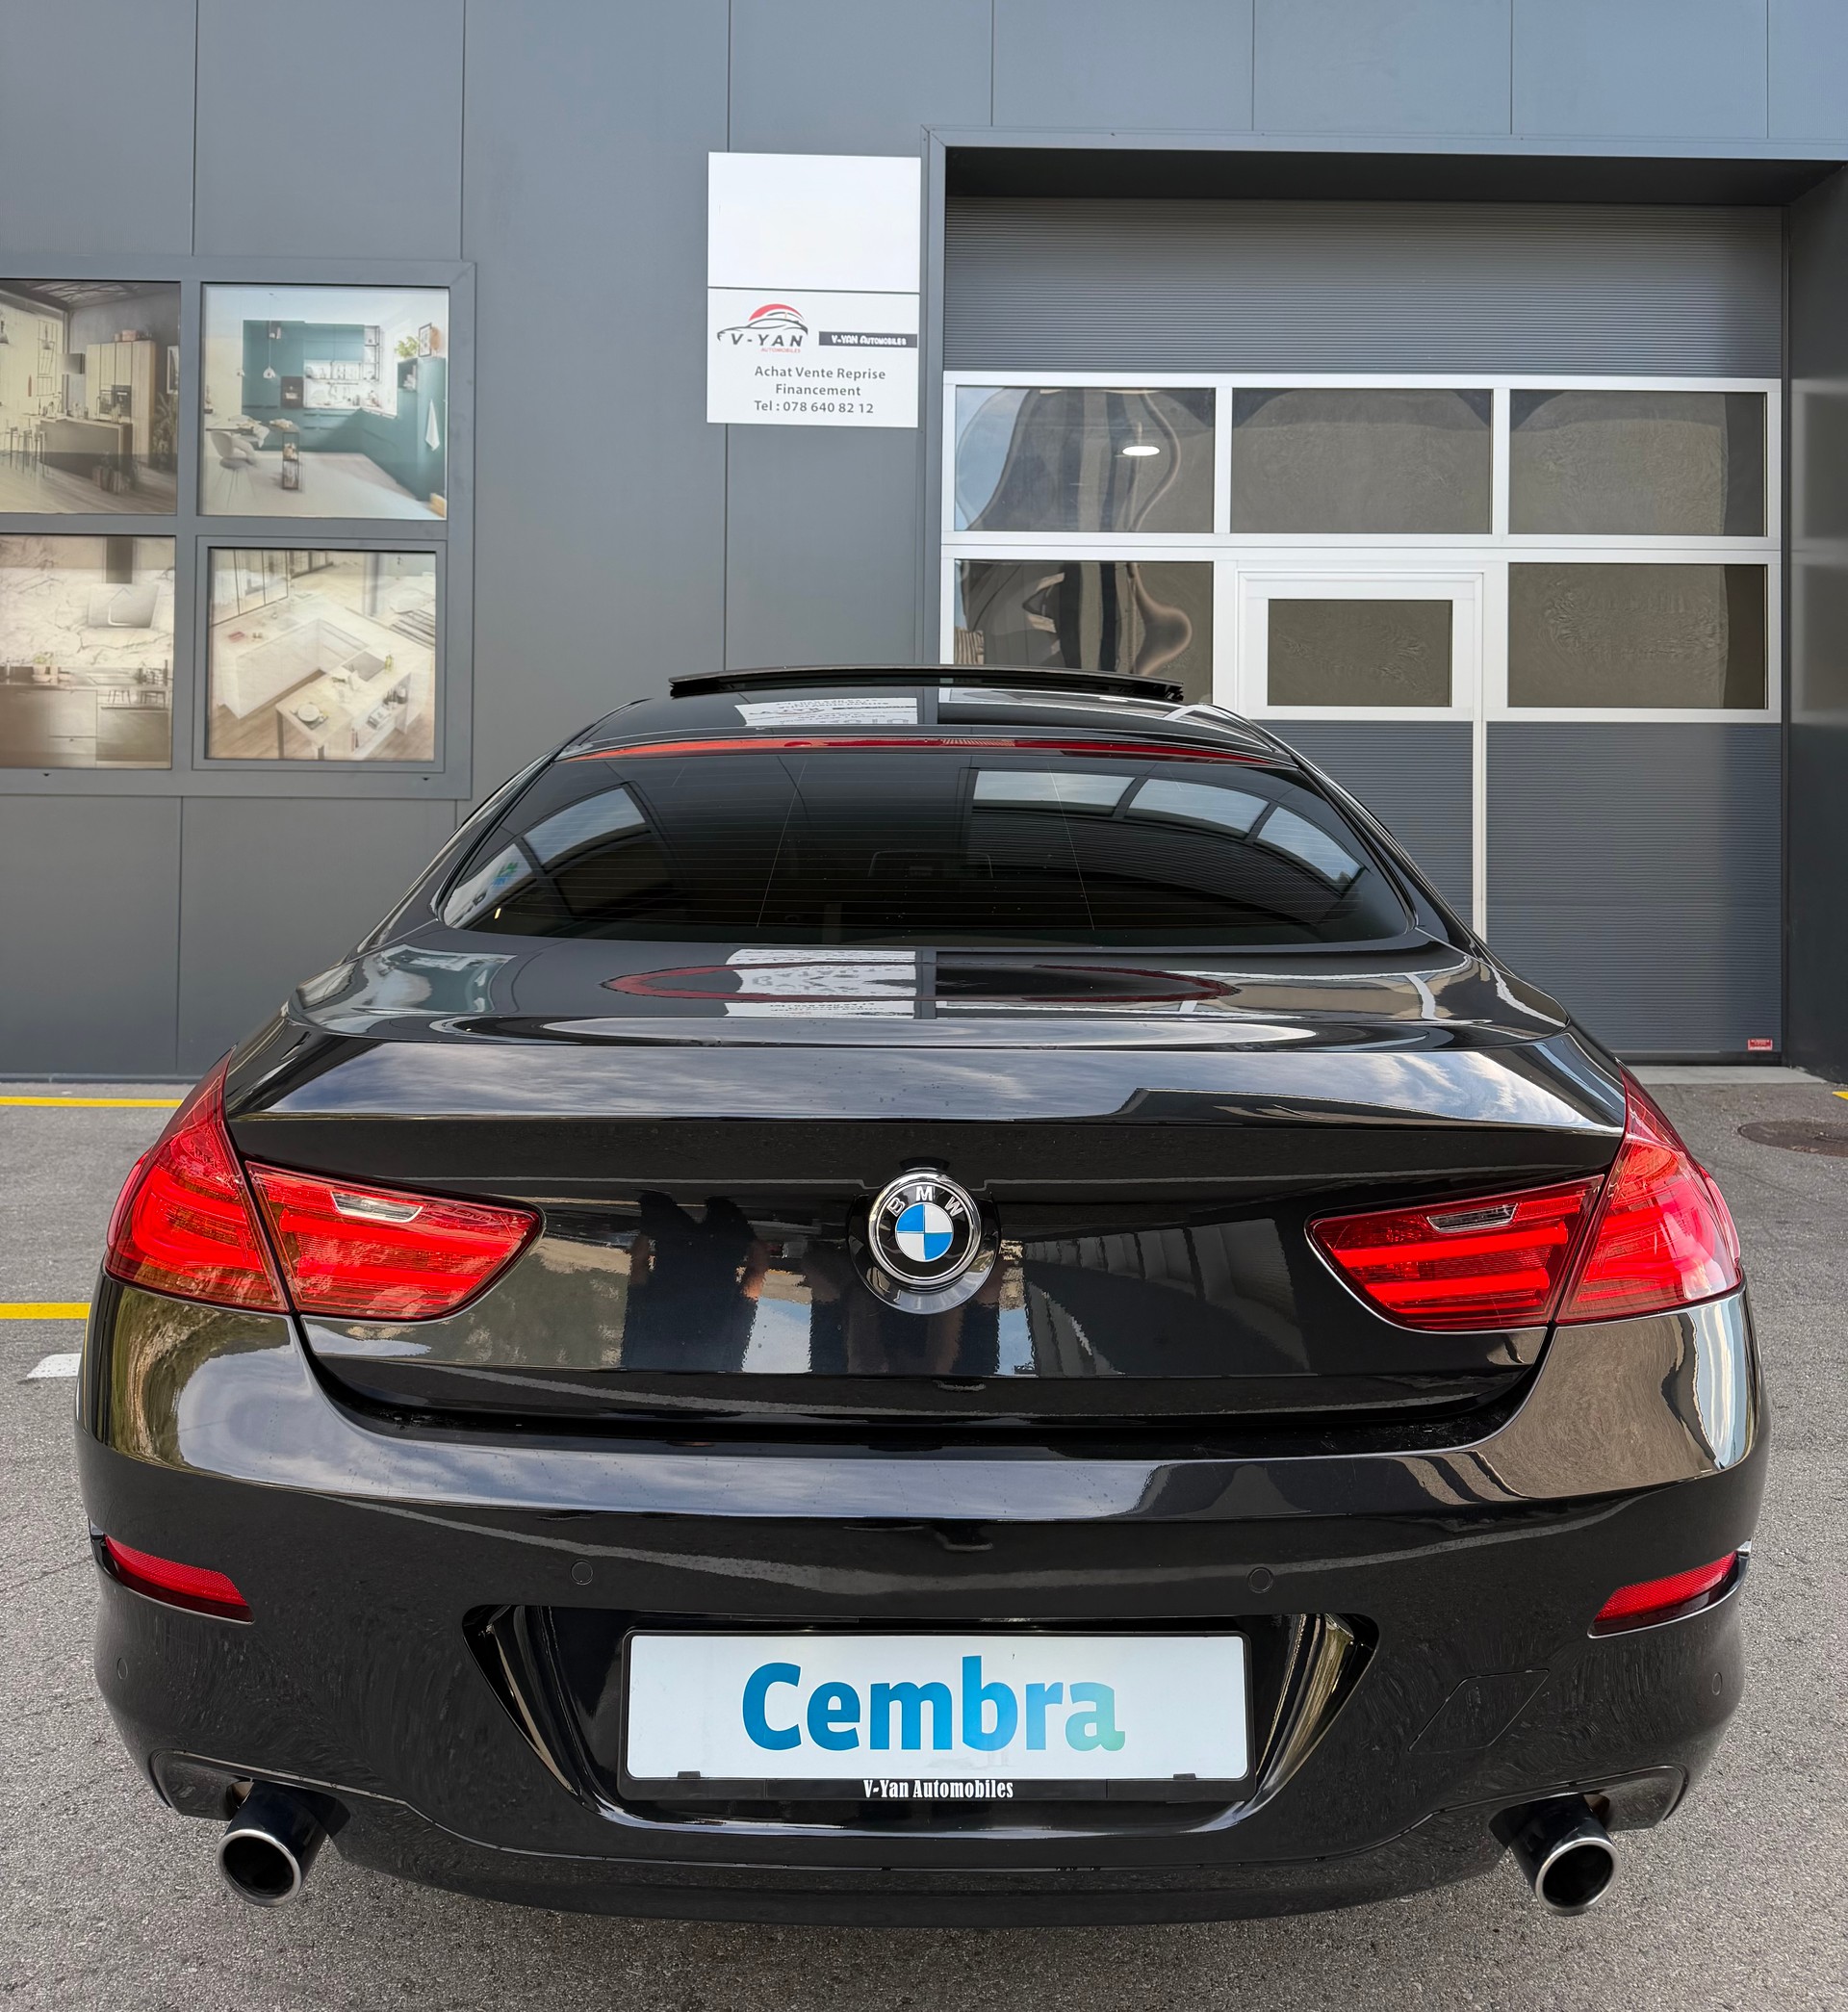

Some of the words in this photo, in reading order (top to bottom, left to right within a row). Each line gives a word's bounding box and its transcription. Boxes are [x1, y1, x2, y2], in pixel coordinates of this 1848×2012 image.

[731, 333, 803, 348] V-YAN
[755, 366, 792, 377] Achat
[795, 367, 834, 378] Vente
[836, 369, 886, 381] Reprise
[775, 384, 861, 396] Financement
[754, 400, 773, 411] Tel
[783, 400, 808, 412] 078
[810, 402, 835, 413] 640
[838, 402, 855, 414] 82
[860, 403, 874, 414] 12
[886, 1185, 964, 1217] BMW
[742, 1655, 1126, 1752] Cembra
[862, 1779, 910, 1798] V-Yan
[912, 1779, 1014, 1798] Automobiles
